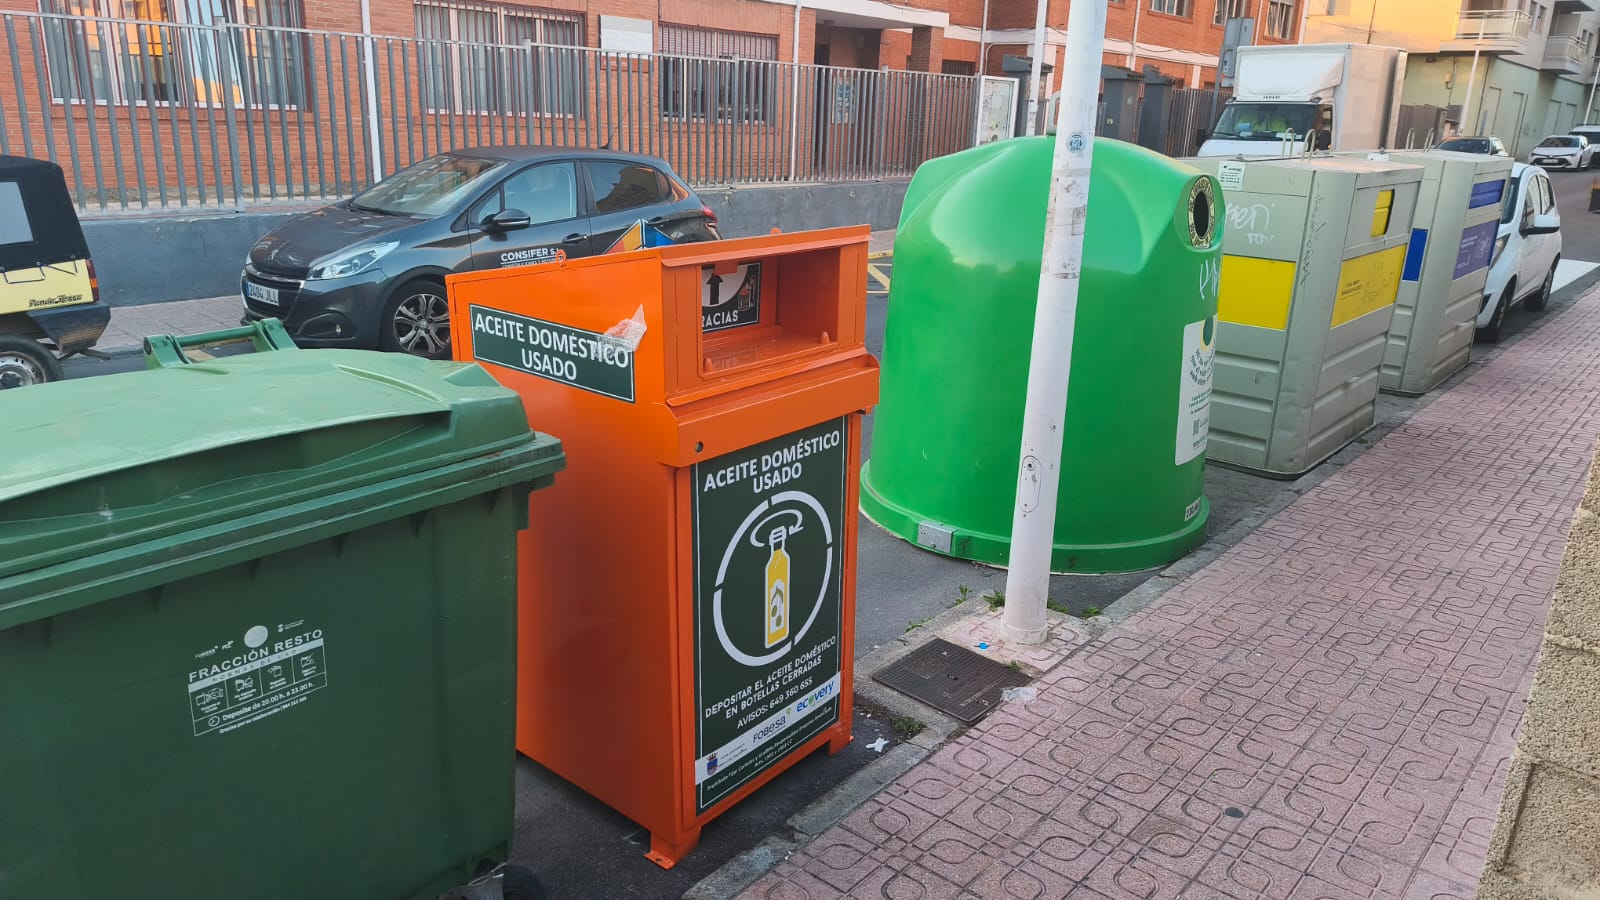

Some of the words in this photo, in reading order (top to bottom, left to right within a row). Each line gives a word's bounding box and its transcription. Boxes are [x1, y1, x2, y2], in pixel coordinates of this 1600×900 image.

[501, 248, 548, 262] CONSIFER
[475, 313, 525, 343] ACEITE
[528, 325, 629, 368] DOMÉSTICO
[521, 348, 577, 380] USADO
[704, 459, 757, 492] ACEITE
[761, 430, 840, 472] DOMÉSTICO
[753, 462, 802, 493] USADO
[189, 647, 268, 682] FRACCIÓN
[275, 629, 322, 652] RESTO
[705, 686, 752, 718] DEPOSITAR
[754, 679, 764, 691] EL
[766, 661, 792, 684] ACEITE
[795, 635, 836, 667] DOMÉSTICO
[726, 705, 738, 719] EN
[741, 681, 780, 710] BOTELLAS
[782, 655, 822, 685] CERRADAS
[737, 705, 769, 729] AVISOS:
[770, 694, 784, 709] 649
[785, 685, 799, 699] 360
[800, 676, 813, 690] 655
